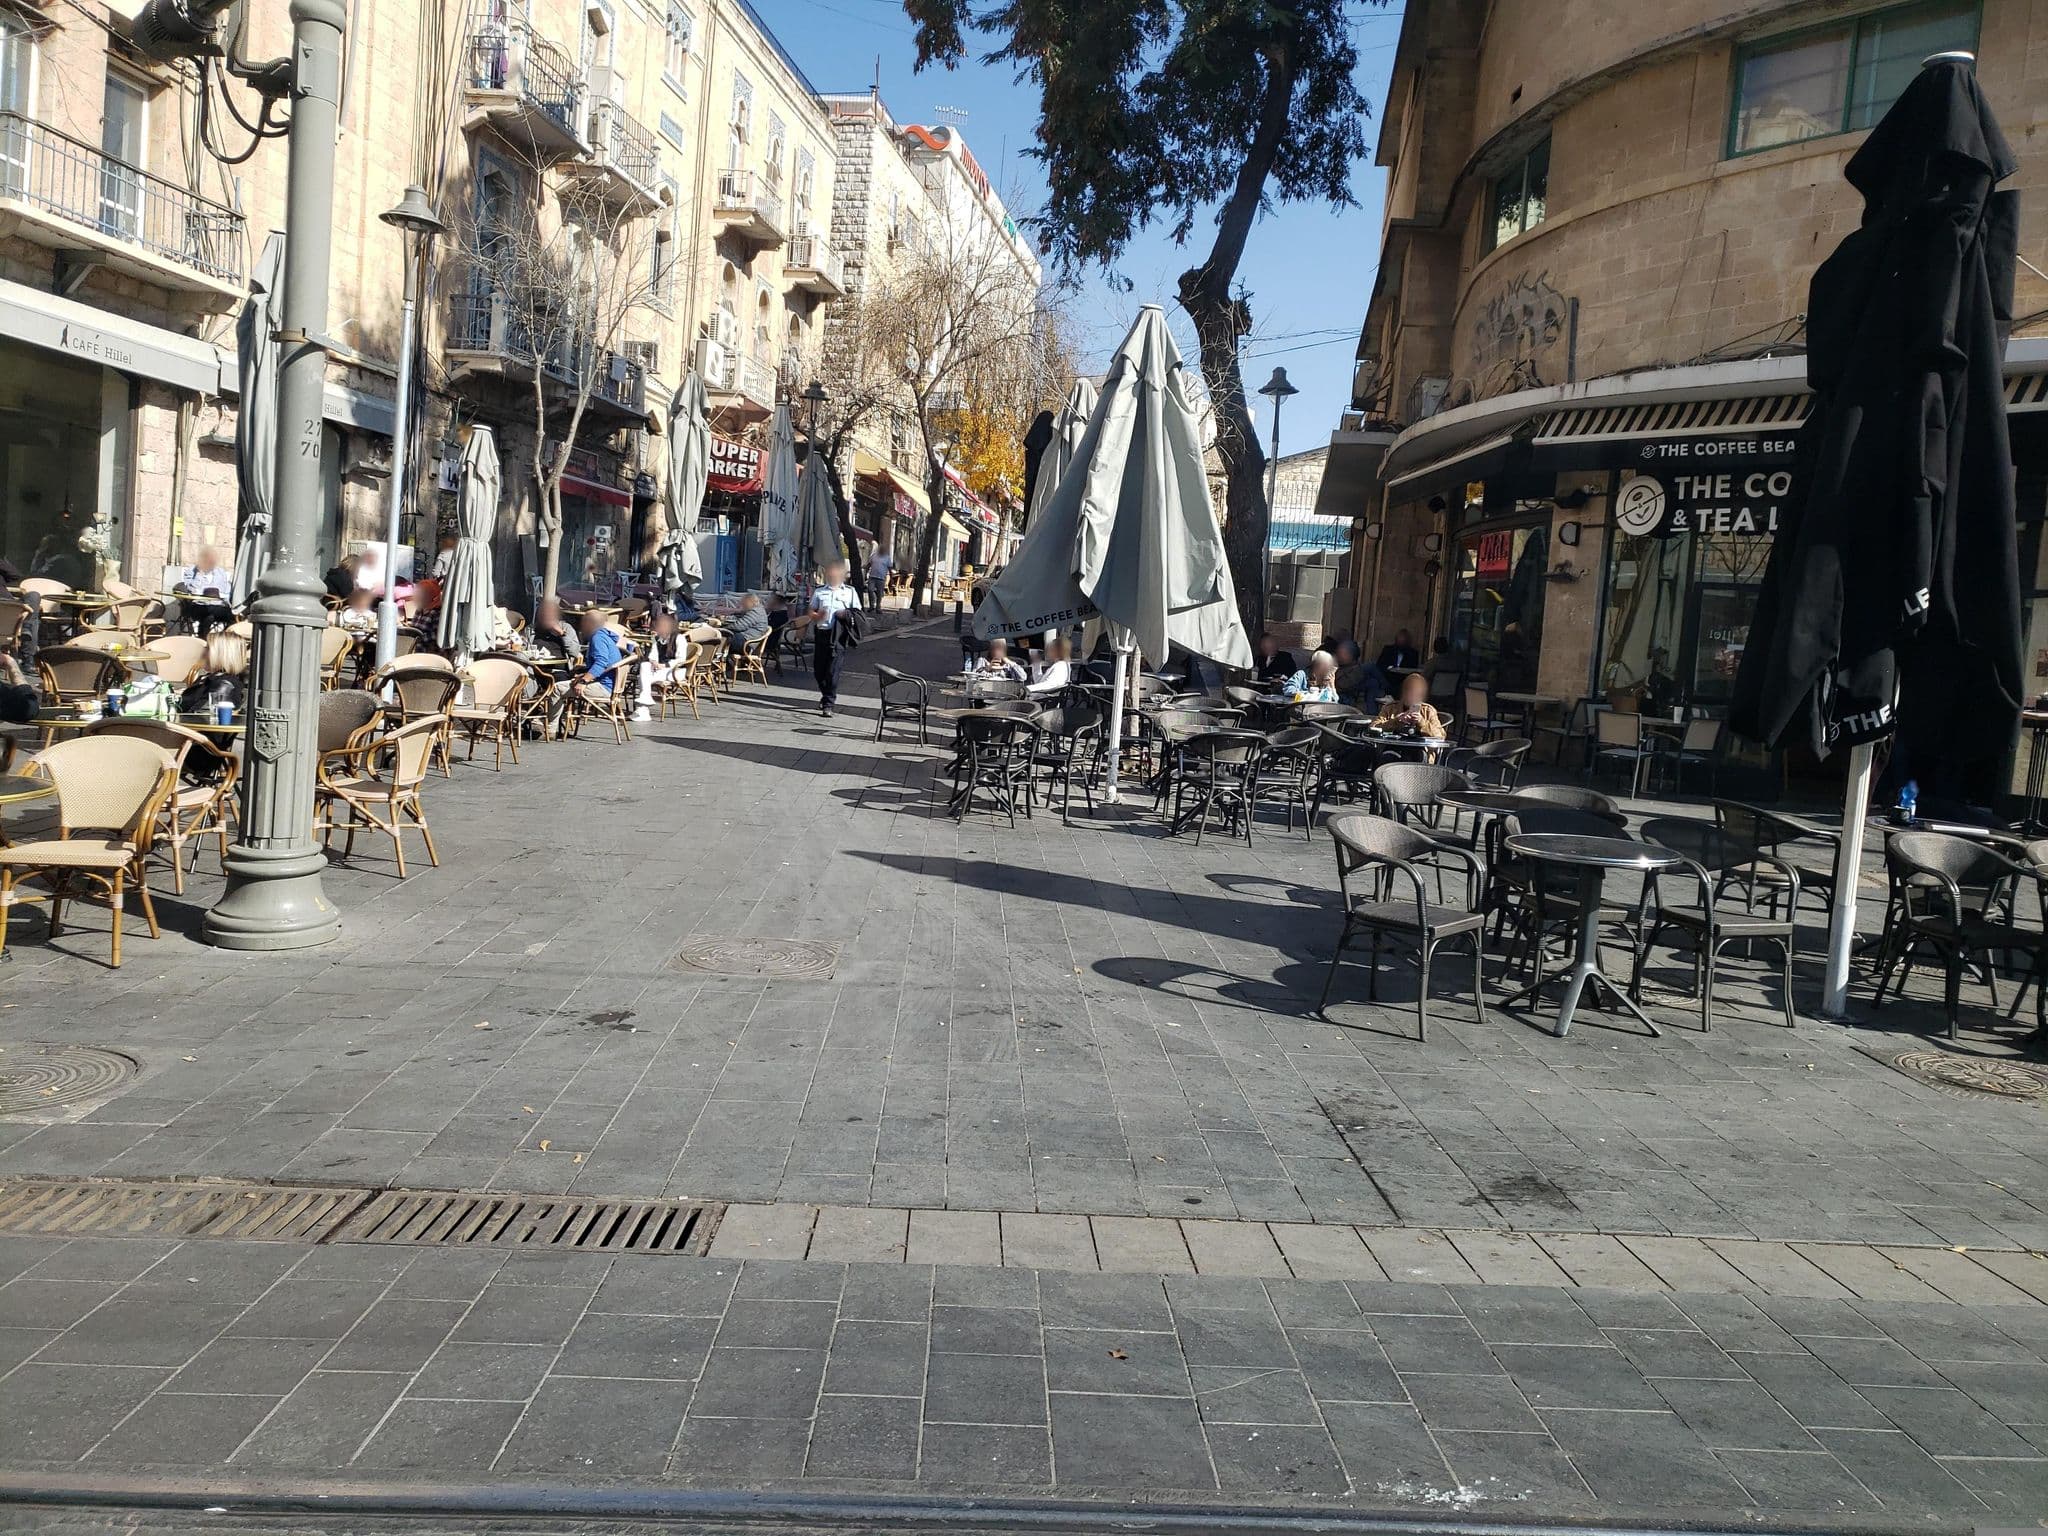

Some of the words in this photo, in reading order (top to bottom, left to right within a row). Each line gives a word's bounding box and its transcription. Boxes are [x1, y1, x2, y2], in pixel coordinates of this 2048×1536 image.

[72, 334, 99, 355] CAFÉ
[104, 346, 132, 365] Hillel
[301, 440, 319, 458] 70
[711, 439, 759, 463] UPER
[1659, 443, 1689, 457] THE
[1694, 441, 1757, 456] COFFEE
[1763, 440, 1795, 453] BEA
[707, 458, 758, 479] ARKET
[1675, 474, 1732, 500] THE
[1744, 472, 1792, 498] CO
[1672, 508, 1688, 527] &
[1696, 507, 1756, 532] TEA
[1768, 506, 1778, 531] L
[1903, 587, 1930, 616] LE
[1000, 621, 1022, 633] THE
[1025, 609, 1074, 630] COFFEE
[1076, 603, 1096, 618] BEA
[1843, 704, 1893, 734] THE
